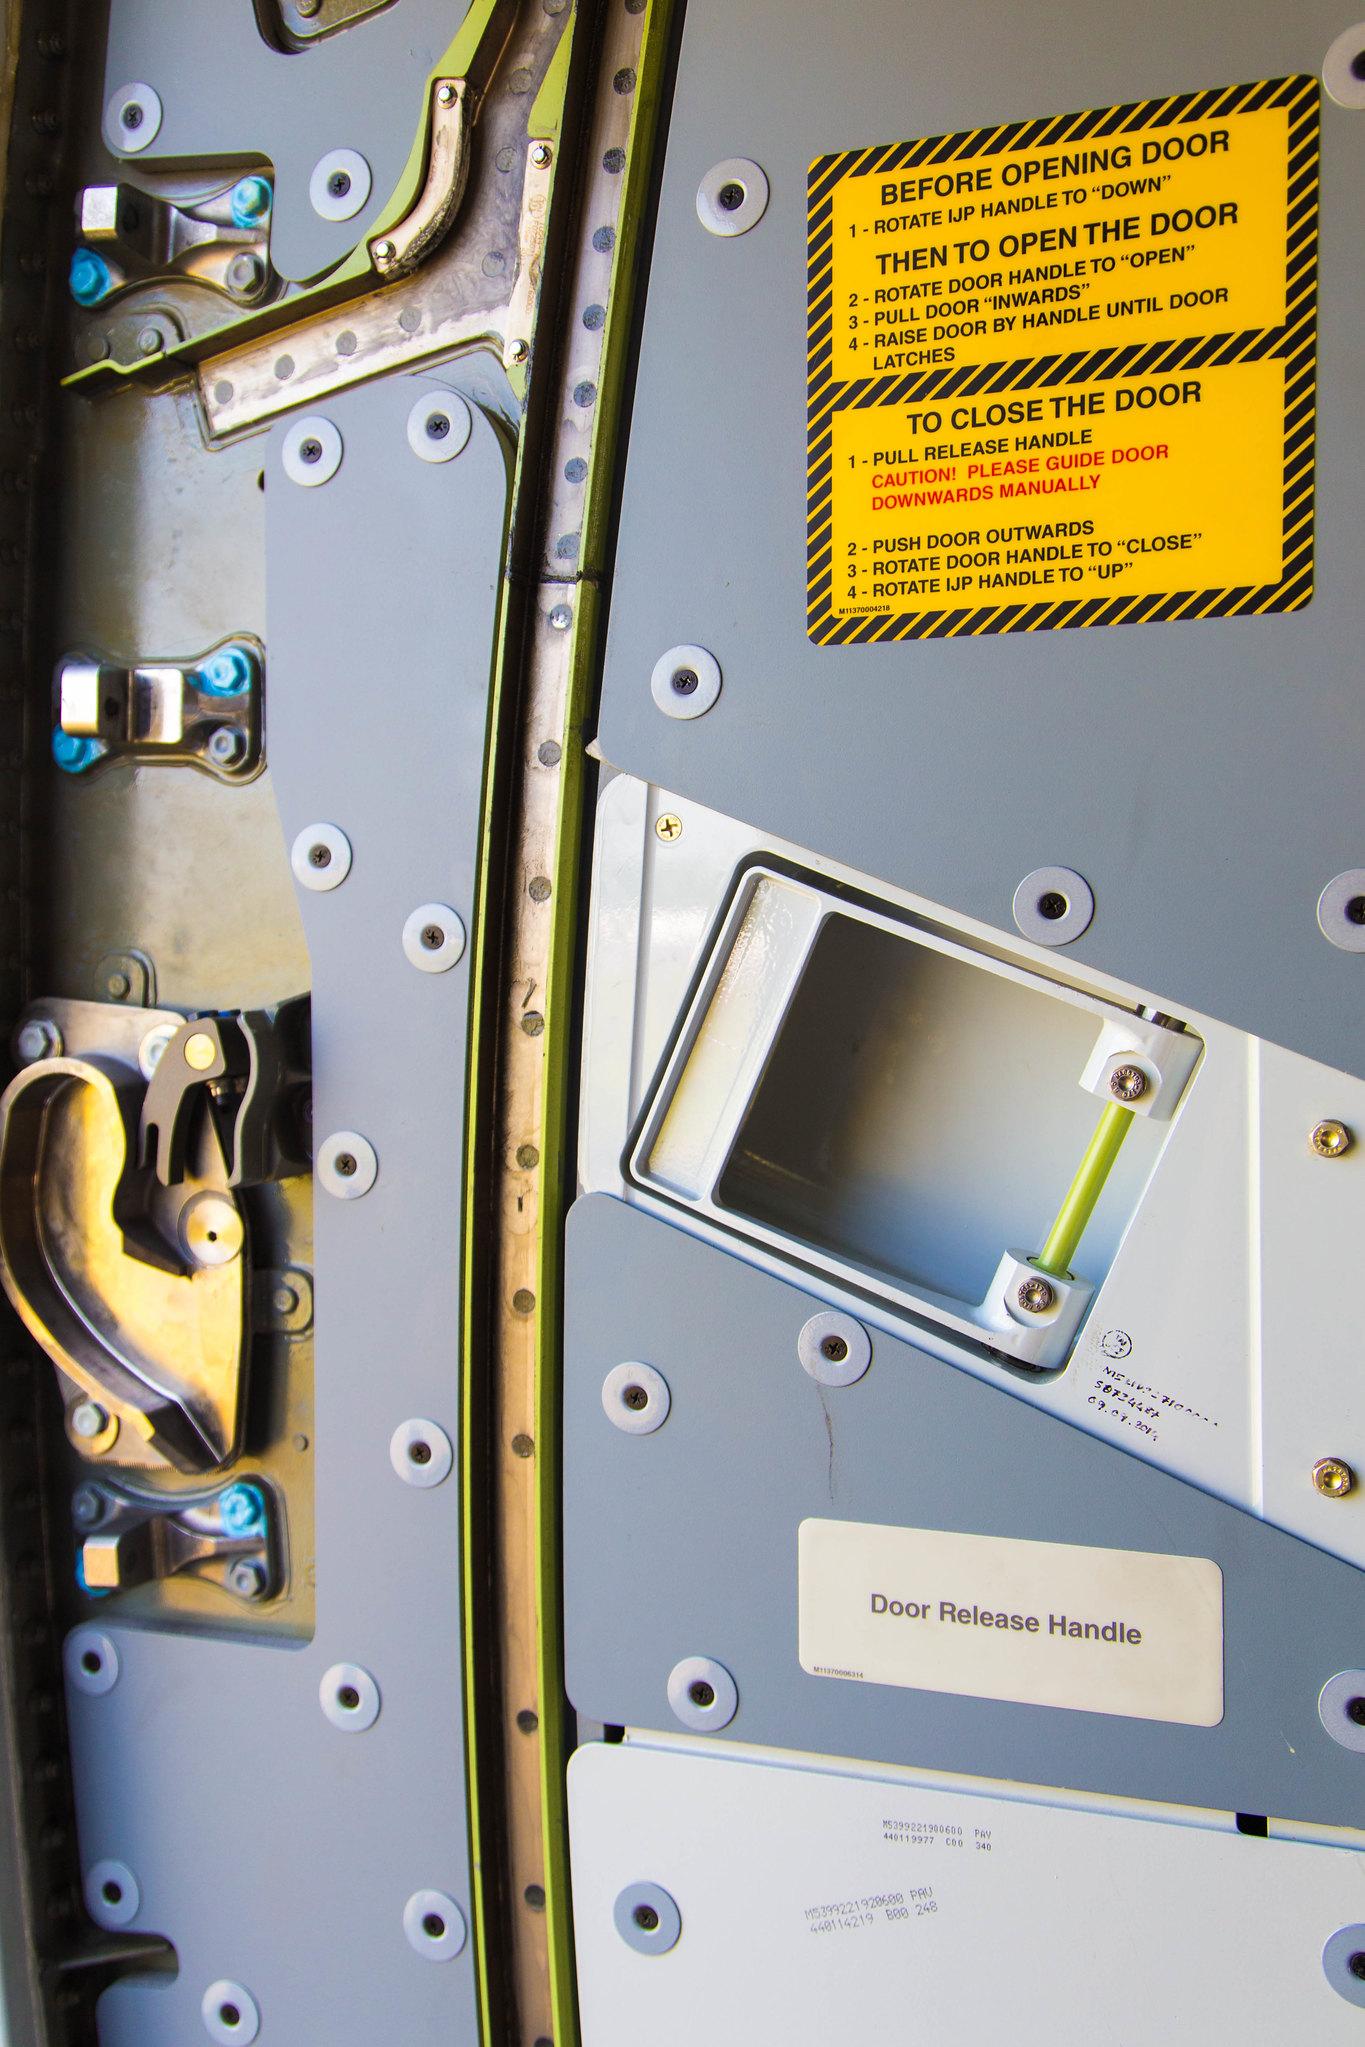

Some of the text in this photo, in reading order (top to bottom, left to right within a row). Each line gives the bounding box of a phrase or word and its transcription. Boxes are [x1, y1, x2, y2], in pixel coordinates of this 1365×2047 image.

[881, 129, 1230, 206] BEFORE OPENING DOOR
[849, 224, 856, 238] 1
[874, 210, 943, 235] ROTATE
[948, 205, 976, 224] IJP
[981, 192, 1058, 219] HANDLE
[1061, 188, 1088, 206] TO
[875, 201, 1239, 276] THEN TO OPEN THE DOOR
[848, 293, 858, 308] 2
[874, 280, 943, 304] ROTATE
[948, 272, 1003, 294] DOOR
[1008, 260, 1087, 286] HANDLE
[1089, 256, 1116, 274] TO
[848, 315, 858, 330] 3
[874, 307, 921, 327] PULL
[925, 298, 980, 320] DOOR
[848, 337, 858, 351] 4
[874, 327, 928, 349] RAISE
[933, 320, 987, 341] DOOR
[993, 315, 1017, 333] BY
[1022, 304, 1101, 330] HANDLE
[1106, 296, 1164, 318] UNTIL
[1169, 287, 1229, 310] DOOR
[873, 346, 956, 371] LATCHES
[906, 380, 1202, 435] TO CLOSE THE DOOR
[848, 455, 855, 469] 1
[873, 448, 919, 467] PULL
[924, 438, 1009, 461] RELEASE
[1015, 428, 1093, 452] HANDLE
[871, 444, 1169, 489] CAUTION! PLEASE GUIDE DOOR
[871, 474, 1101, 511] DOWNWARDS MANUALLY
[847, 542, 857, 556] 2
[873, 535, 921, 554] PUSH
[927, 530, 981, 550] DOOR
[986, 519, 1095, 544] OUTWARDS
[847, 563, 857, 578] 3
[873, 556, 941, 576] ROTATE
[946, 551, 1000, 570] DOOR
[1006, 543, 1083, 565] HANDLE
[1086, 541, 1113, 558] TO
[847, 585, 857, 599] 4
[873, 578, 941, 598] ROTATE
[946, 575, 973, 592] IJP
[978, 568, 1055, 589] HANDLE
[1058, 566, 1084, 583] TO
[838, 604, 891, 615] M11370004218
[871, 1593, 1142, 1645] Door Release Handle
[975, 1841, 992, 1851] 340
